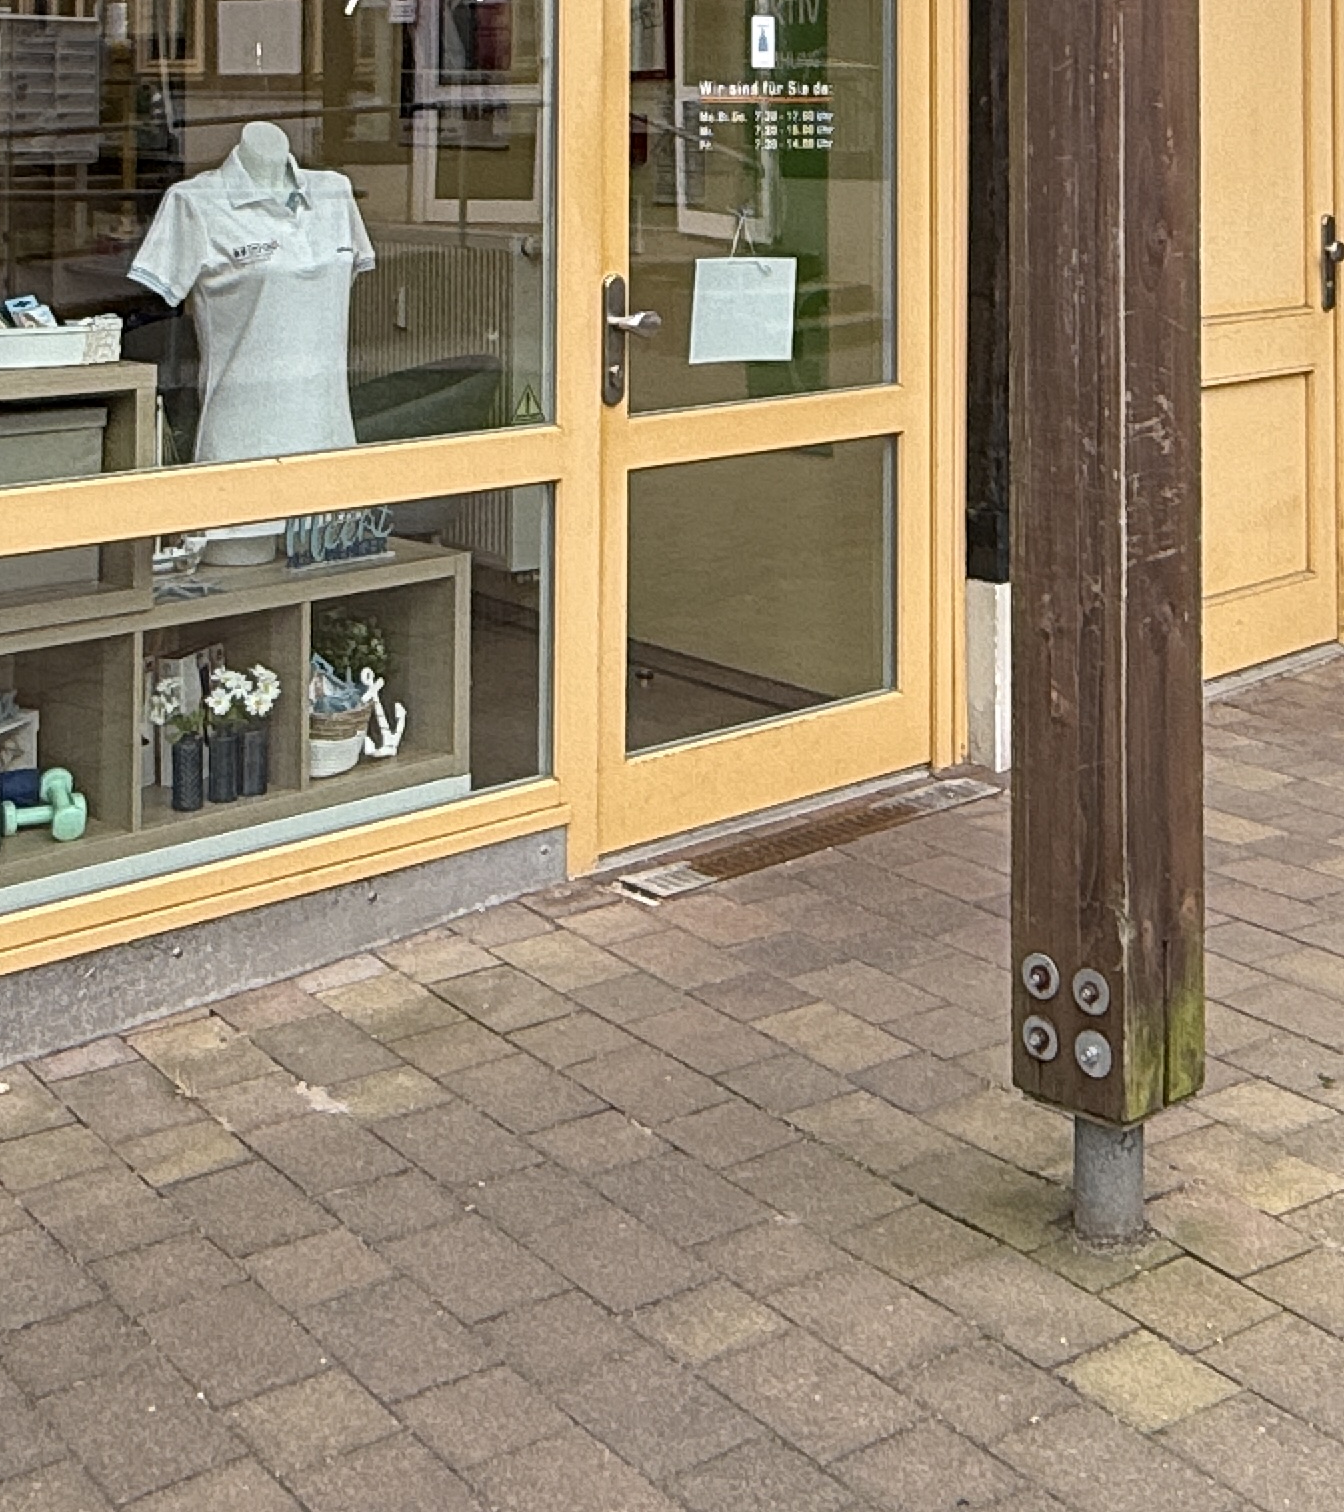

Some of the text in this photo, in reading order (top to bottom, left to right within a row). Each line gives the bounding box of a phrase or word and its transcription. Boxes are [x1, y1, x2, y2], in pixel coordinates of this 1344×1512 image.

[699, 80, 724, 96] Wir
[728, 80, 759, 96] sind
[762, 80, 784, 96] für
[788, 80, 810, 96] Sie
